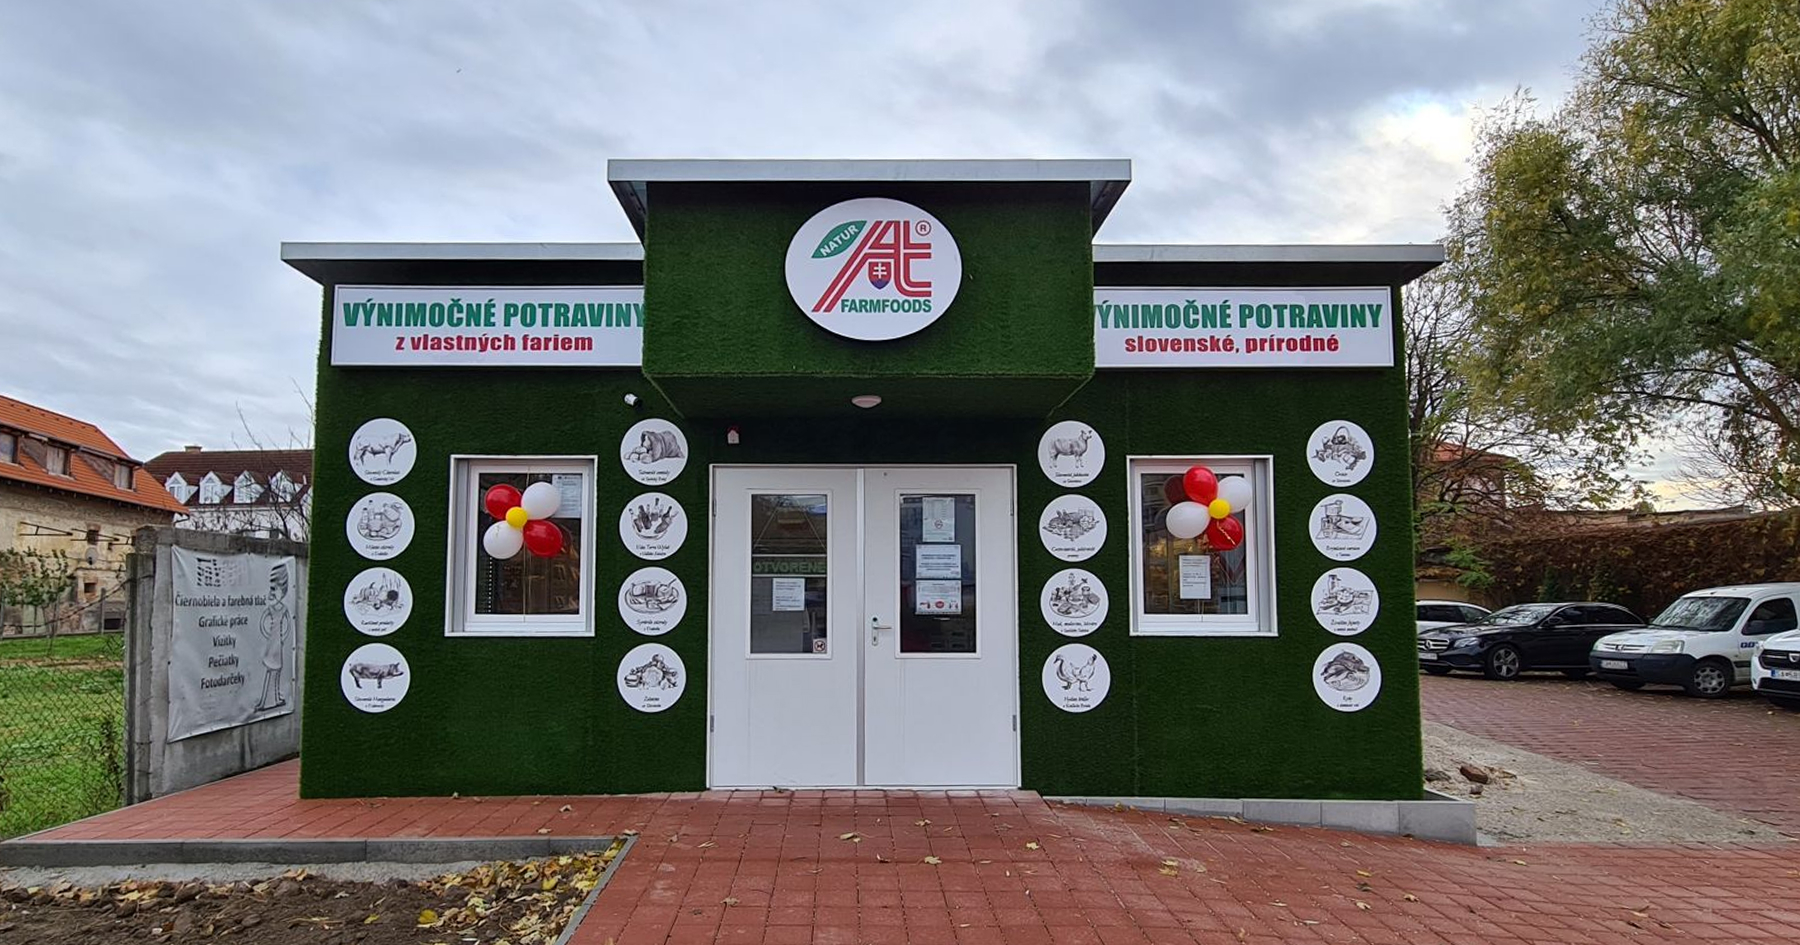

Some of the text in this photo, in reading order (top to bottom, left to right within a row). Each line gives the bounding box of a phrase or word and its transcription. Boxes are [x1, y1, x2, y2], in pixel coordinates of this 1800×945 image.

[819, 224, 860, 257] NATUR
[342, 298, 645, 328] VÝNIMOČNÉ POTRAVINY
[840, 298, 932, 313] FARMFOODS
[1095, 299, 1383, 329] ÝNIMOČNÉ POTRAVINY
[395, 333, 594, 353] z vlastných fariem
[1124, 334, 1340, 354] slovenské, prírodné
[174, 591, 221, 608] Čiernobiela
[198, 613, 248, 629] Grafické práce
[212, 634, 237, 649] Vizitky
[208, 654, 240, 670] Pečiatky
[200, 673, 246, 690] Fotodarčeky
